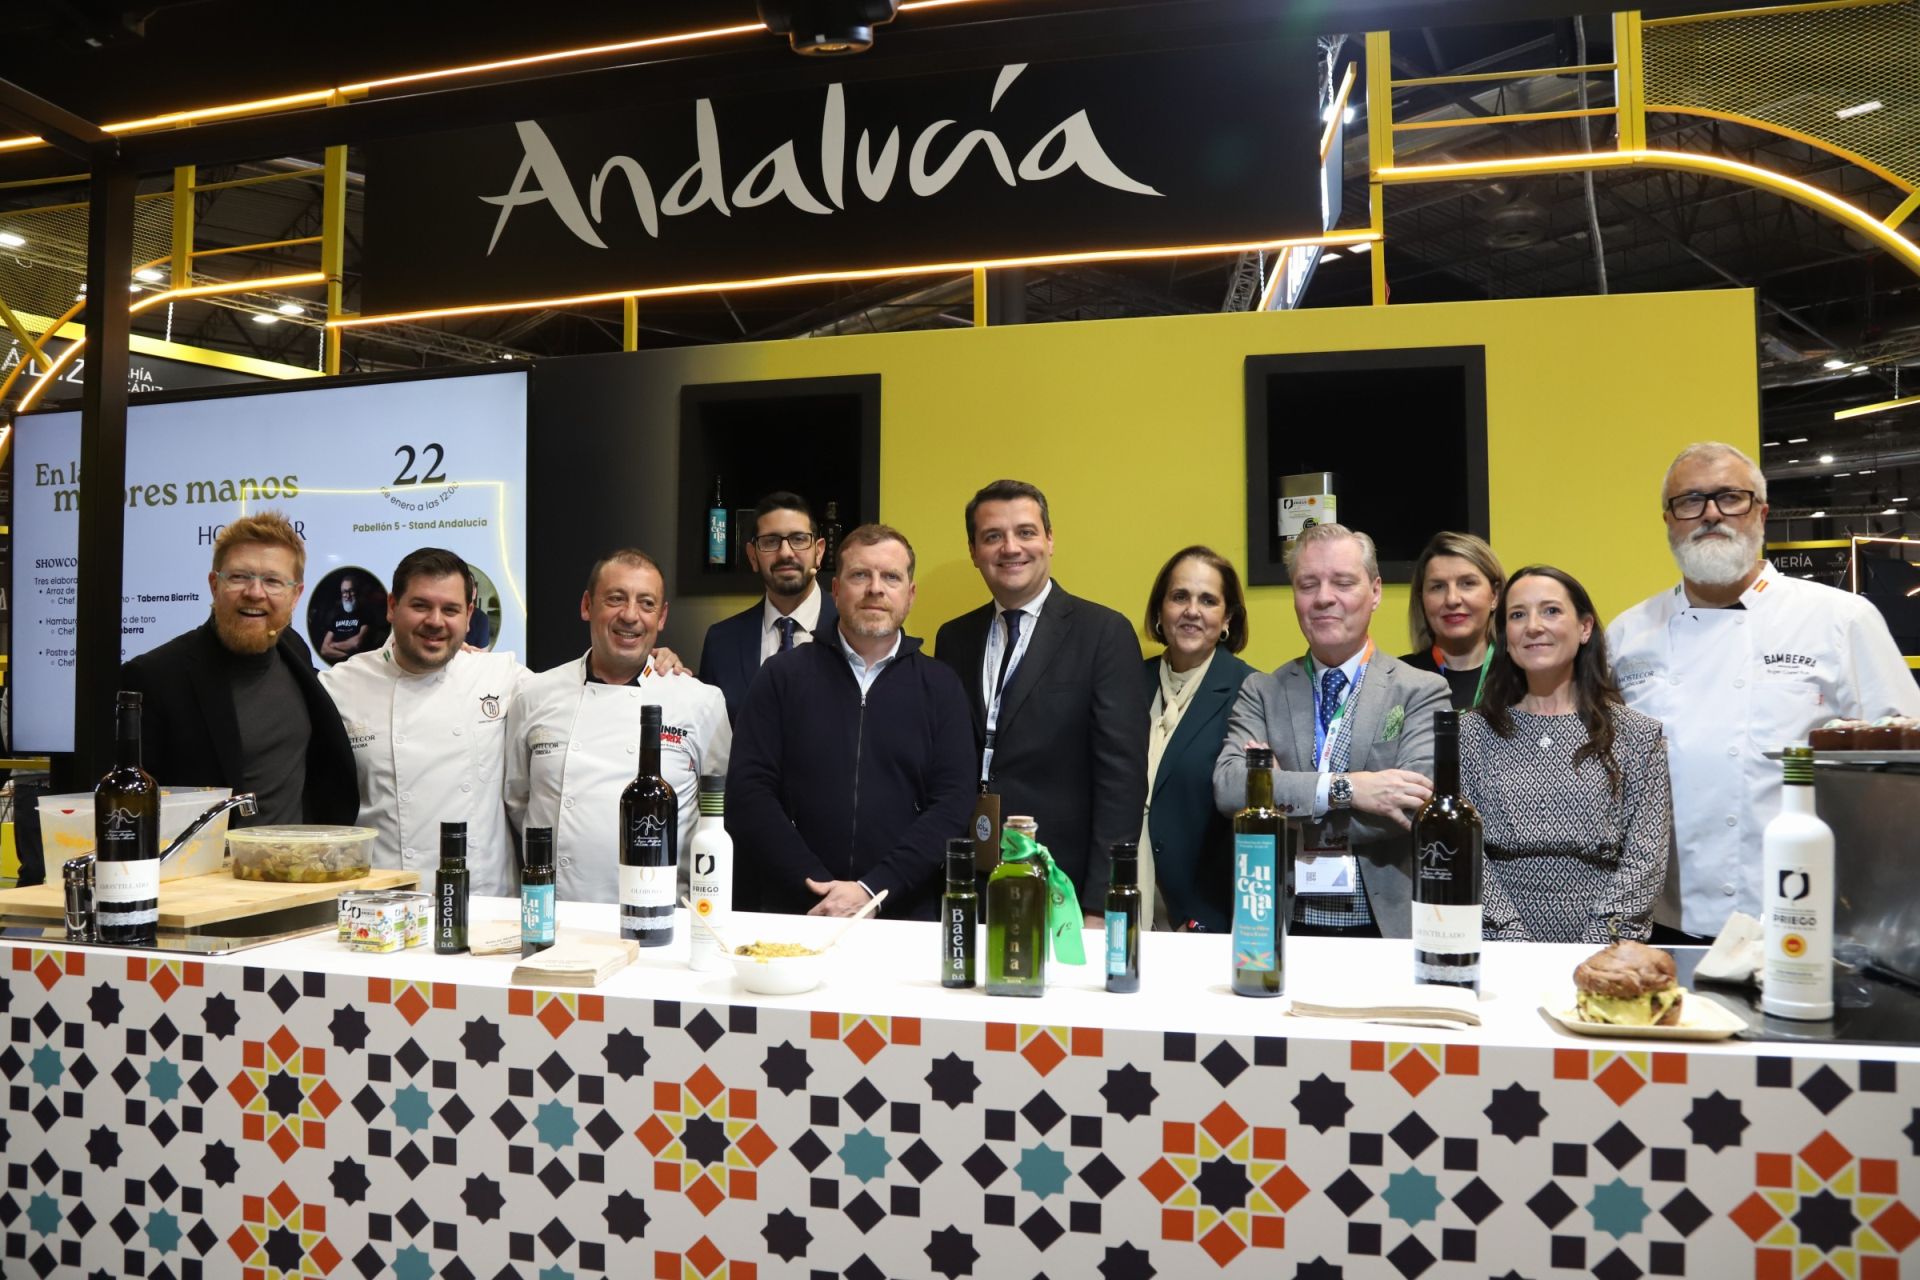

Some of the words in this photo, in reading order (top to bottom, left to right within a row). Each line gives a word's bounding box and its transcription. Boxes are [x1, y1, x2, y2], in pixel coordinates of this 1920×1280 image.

[478, 63, 1166, 257] Andalucía
[35, 463, 65, 486] En
[393, 443, 446, 485] 22
[186, 474, 299, 504] manos
[390, 495, 415, 511] enero
[426, 497, 440, 510] las
[353, 522, 392, 532] Pabellón
[394, 522, 400, 530] 5
[409, 520, 436, 530] Stand
[438, 517, 487, 528] Andalucía
[65, 586, 75, 595] de
[137, 594, 170, 603] Taberna
[171, 593, 199, 602] Biarritz
[443, 883, 455, 938] Baena
[952, 908, 965, 970] Baena
